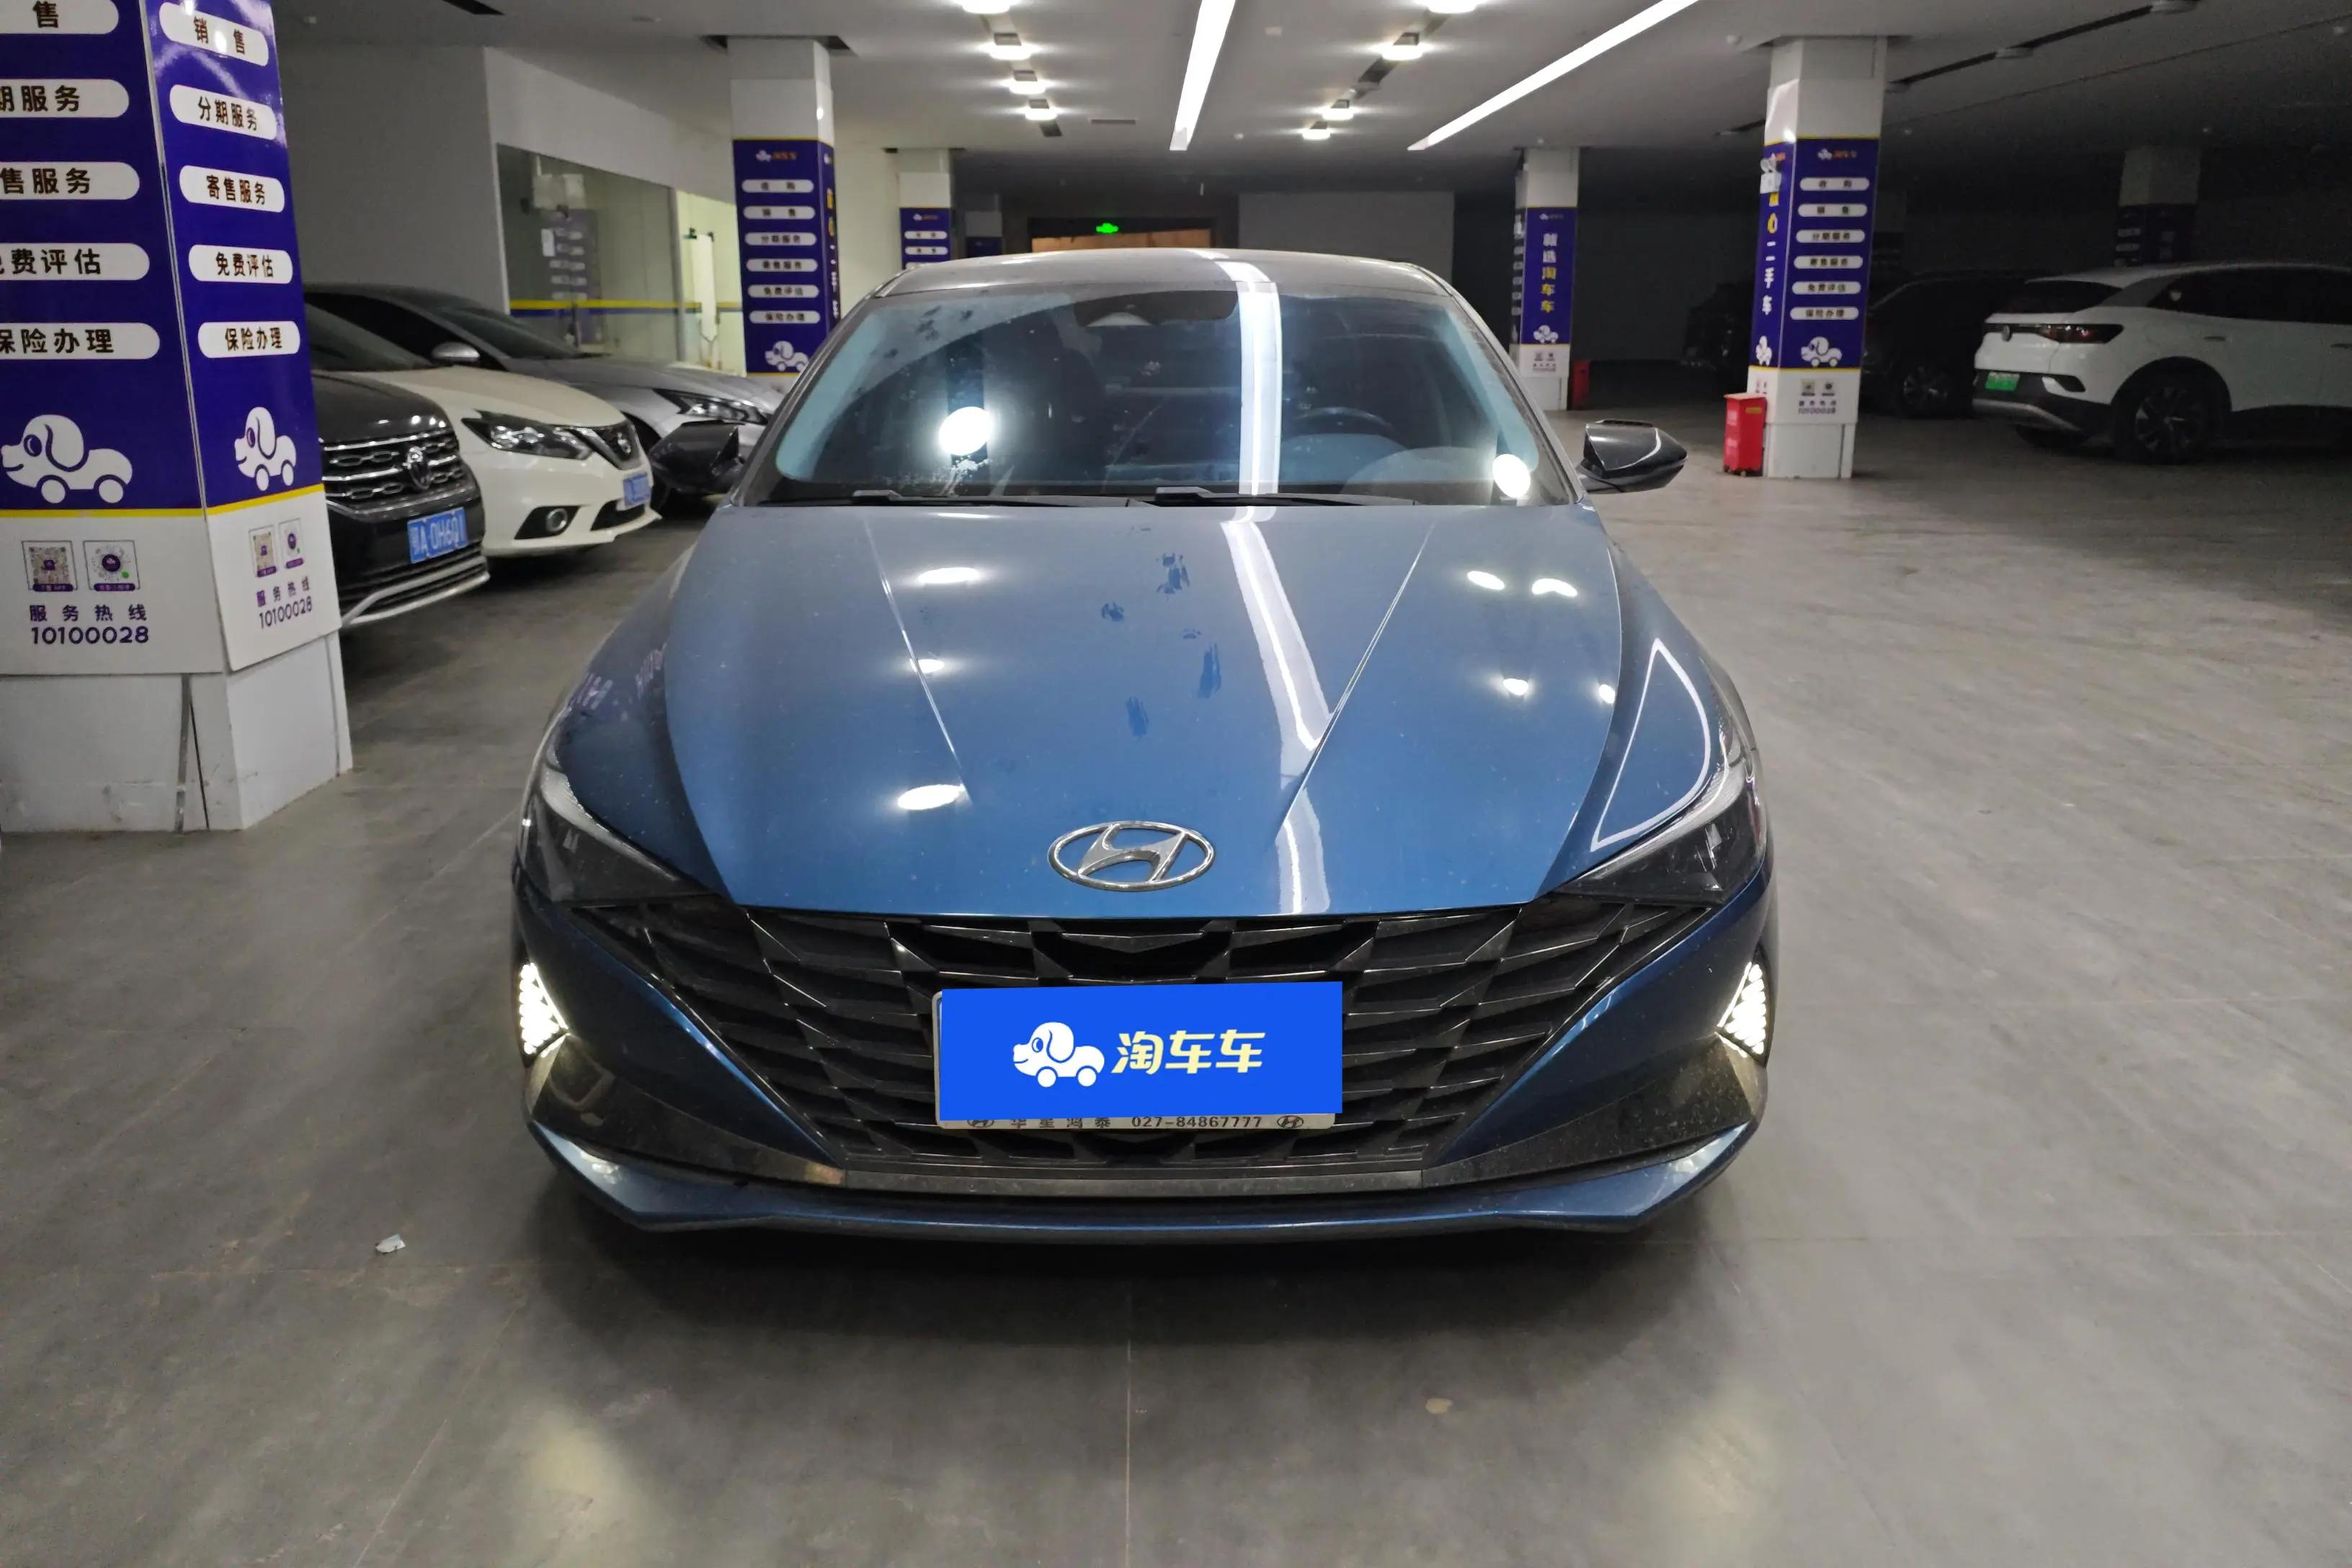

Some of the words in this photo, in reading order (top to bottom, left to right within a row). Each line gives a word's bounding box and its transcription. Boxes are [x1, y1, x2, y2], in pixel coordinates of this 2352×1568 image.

[197, 96, 257, 131] 分期服务
[206, 174, 266, 205] 寄售服务
[0, 248, 101, 275] 费评估
[215, 253, 274, 278] 免费评估
[0, 328, 115, 354] 保险办理
[225, 326, 282, 350] 保险办理
[30, 604, 147, 622] 服务热线
[259, 596, 312, 629] 10100028
[31, 625, 149, 645] 10100028
[1131, 1116, 1262, 1128] 027-84867777
